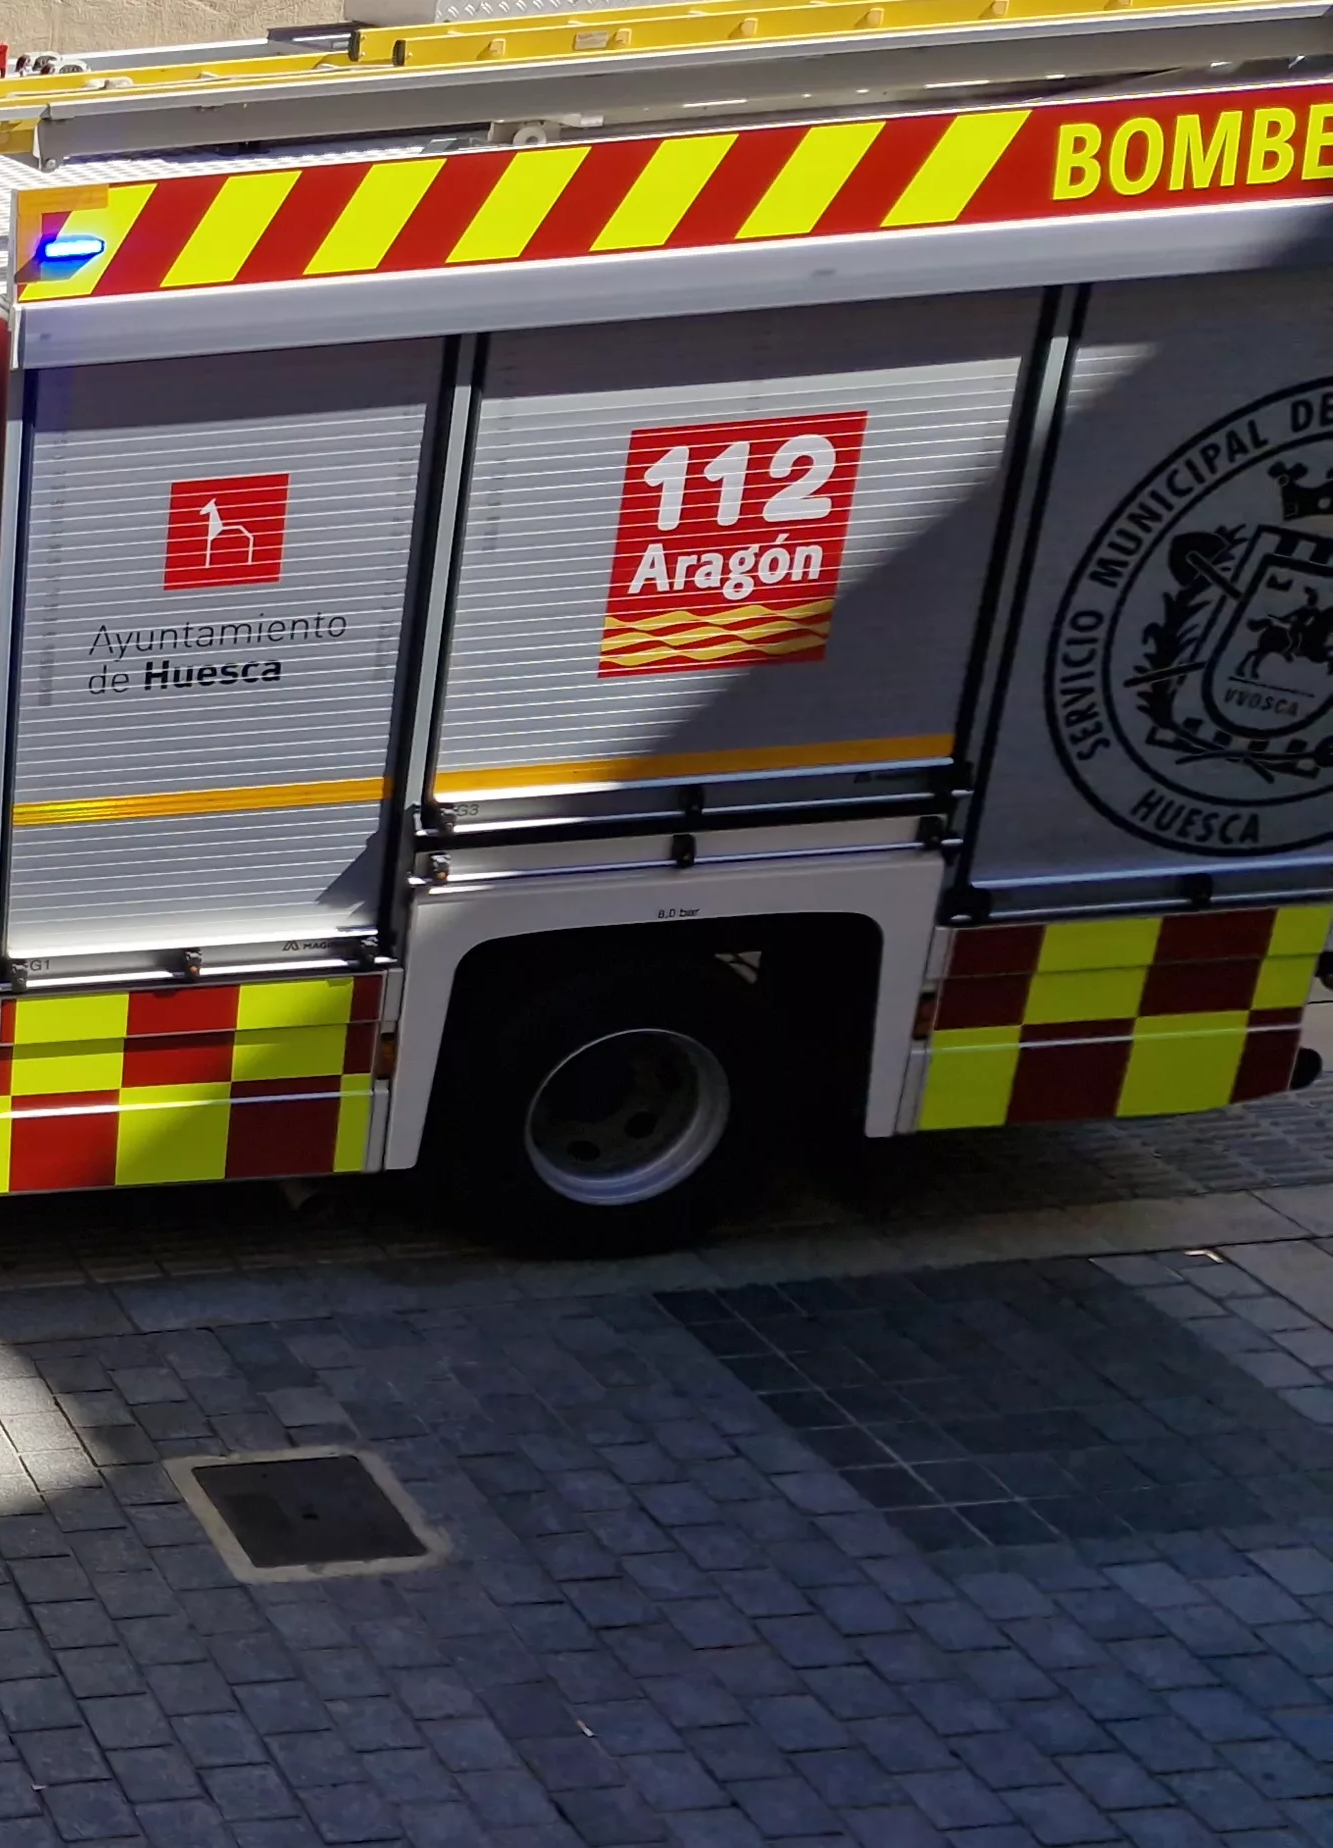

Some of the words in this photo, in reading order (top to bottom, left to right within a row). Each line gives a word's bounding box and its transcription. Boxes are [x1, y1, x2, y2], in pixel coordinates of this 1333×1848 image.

[1051, 103, 1333, 200] BOMBE
[644, 434, 837, 530] 112
[628, 534, 824, 600] Aragón
[1060, 610, 1110, 761] SERVICIO
[1088, 419, 1269, 588] MUNICIPAL
[88, 612, 347, 661] Ayuntamiento
[88, 665, 131, 694] de
[144, 659, 281, 691] Huesca
[1130, 788, 1260, 844] HUESCA
[30, 959, 50, 971] G1
